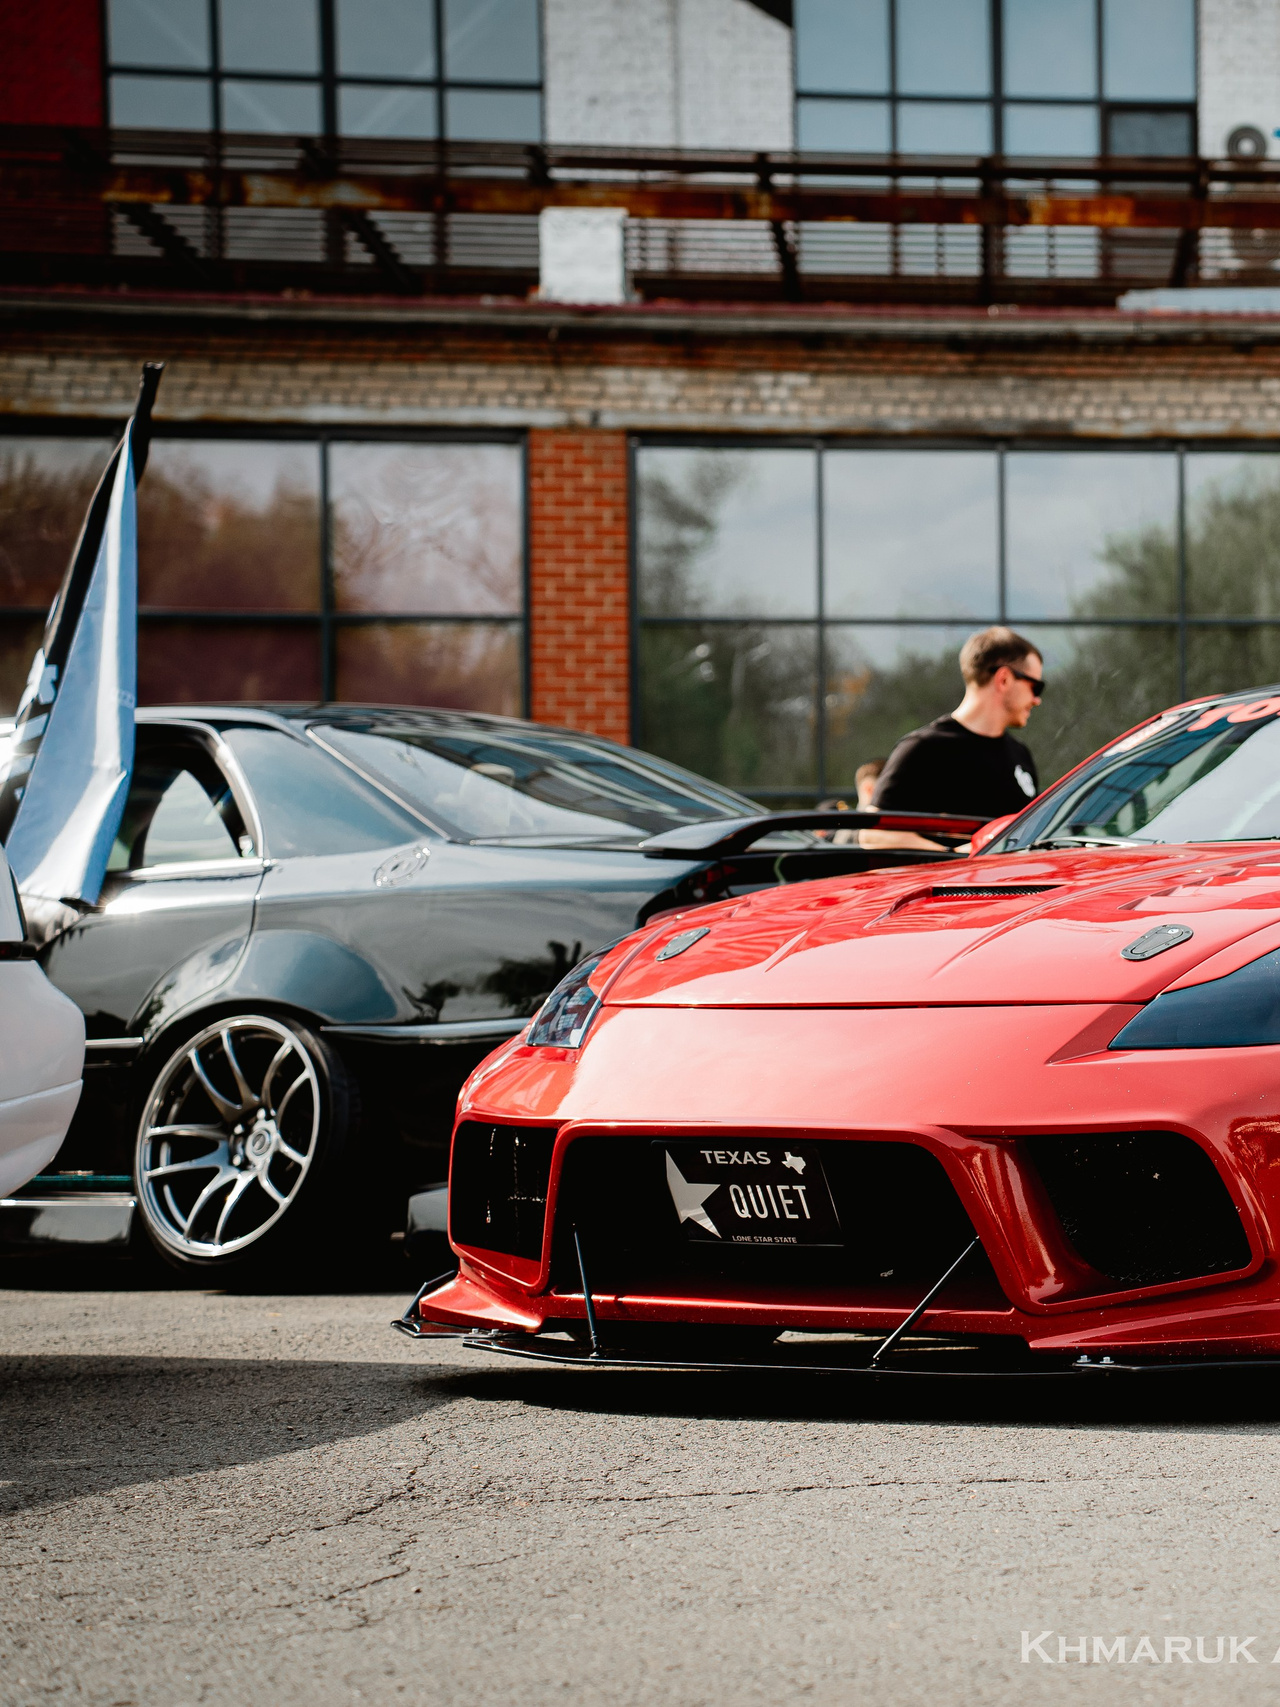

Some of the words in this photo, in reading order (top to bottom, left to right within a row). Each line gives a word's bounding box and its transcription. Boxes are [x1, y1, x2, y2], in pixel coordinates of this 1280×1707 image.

[700, 1150, 771, 1165] TEXAS
[729, 1184, 811, 1219] QUIET
[732, 1235, 752, 1243] LONE
[774, 1236, 797, 1244] STATE
